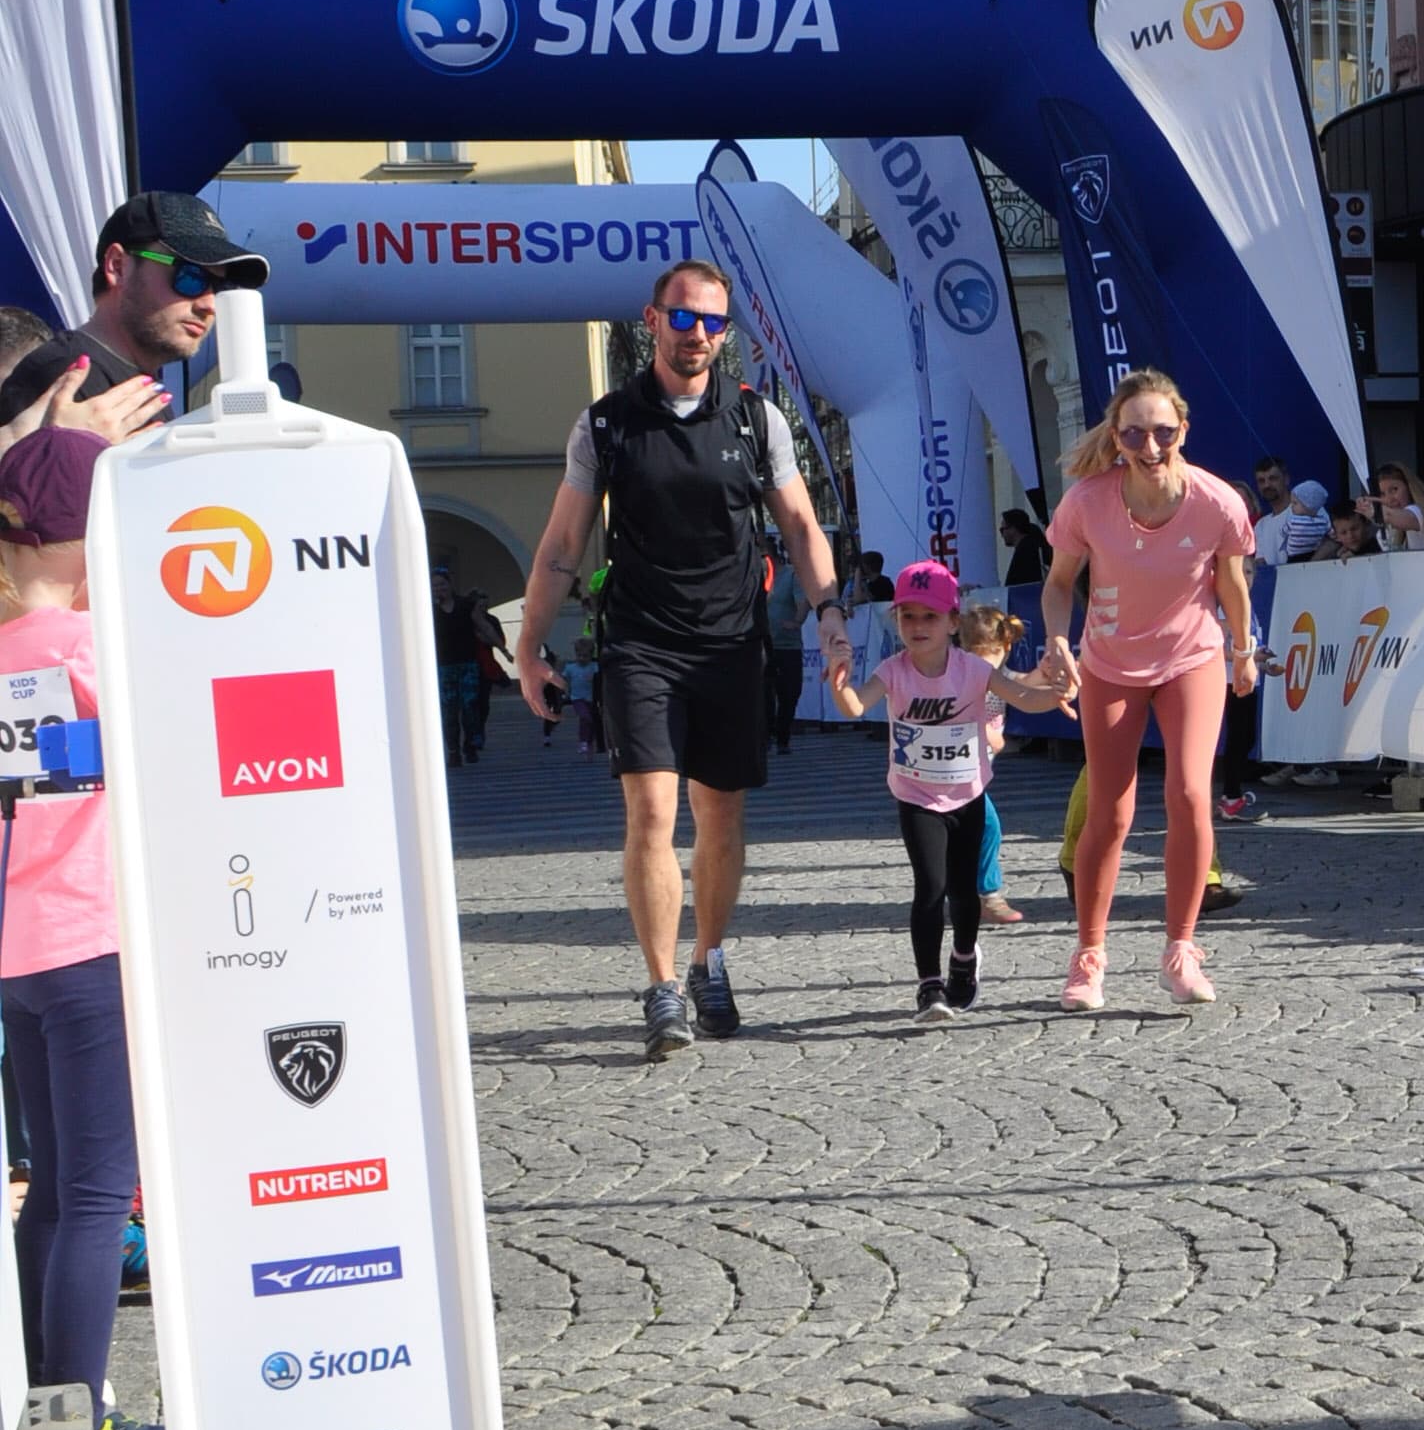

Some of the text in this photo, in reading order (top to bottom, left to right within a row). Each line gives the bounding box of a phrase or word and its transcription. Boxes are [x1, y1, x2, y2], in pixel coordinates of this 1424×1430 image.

[358, 219, 700, 265] INTERSPORT
[294, 534, 370, 570] NN
[1317, 643, 1339, 675] NN
[1374, 636, 1409, 669] NN
[9, 677, 37, 689] KIDS
[12, 689, 36, 700] CUP
[907, 698, 957, 719] NIKE
[922, 744, 970, 760] 3154
[233, 757, 328, 786] AVON
[327, 888, 383, 903] Powered
[328, 902, 383, 919] by MVM
[207, 948, 287, 971] innogy
[272, 1028, 338, 1043] PEUGEOT
[257, 1165, 382, 1199] NUTREND
[308, 1344, 412, 1380] ŠKODA
